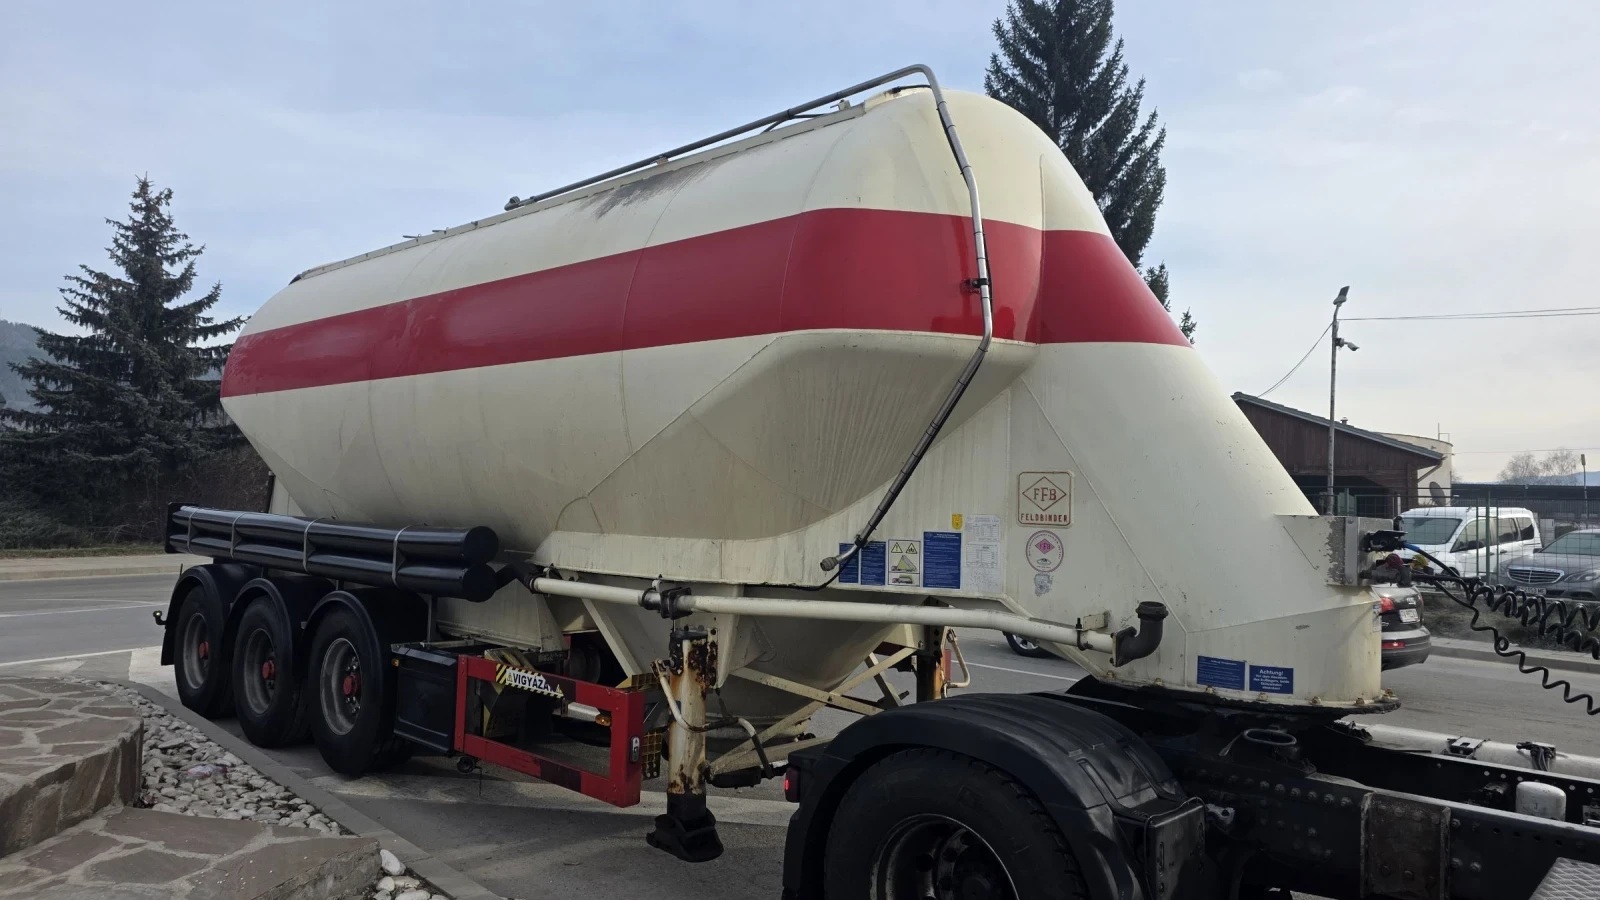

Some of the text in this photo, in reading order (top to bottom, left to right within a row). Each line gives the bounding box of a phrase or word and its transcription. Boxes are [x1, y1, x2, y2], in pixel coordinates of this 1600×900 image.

[1033, 487, 1057, 502] FFB
[1020, 512, 1068, 523] FELDBINDER
[1259, 669, 1284, 677] Achtung!
